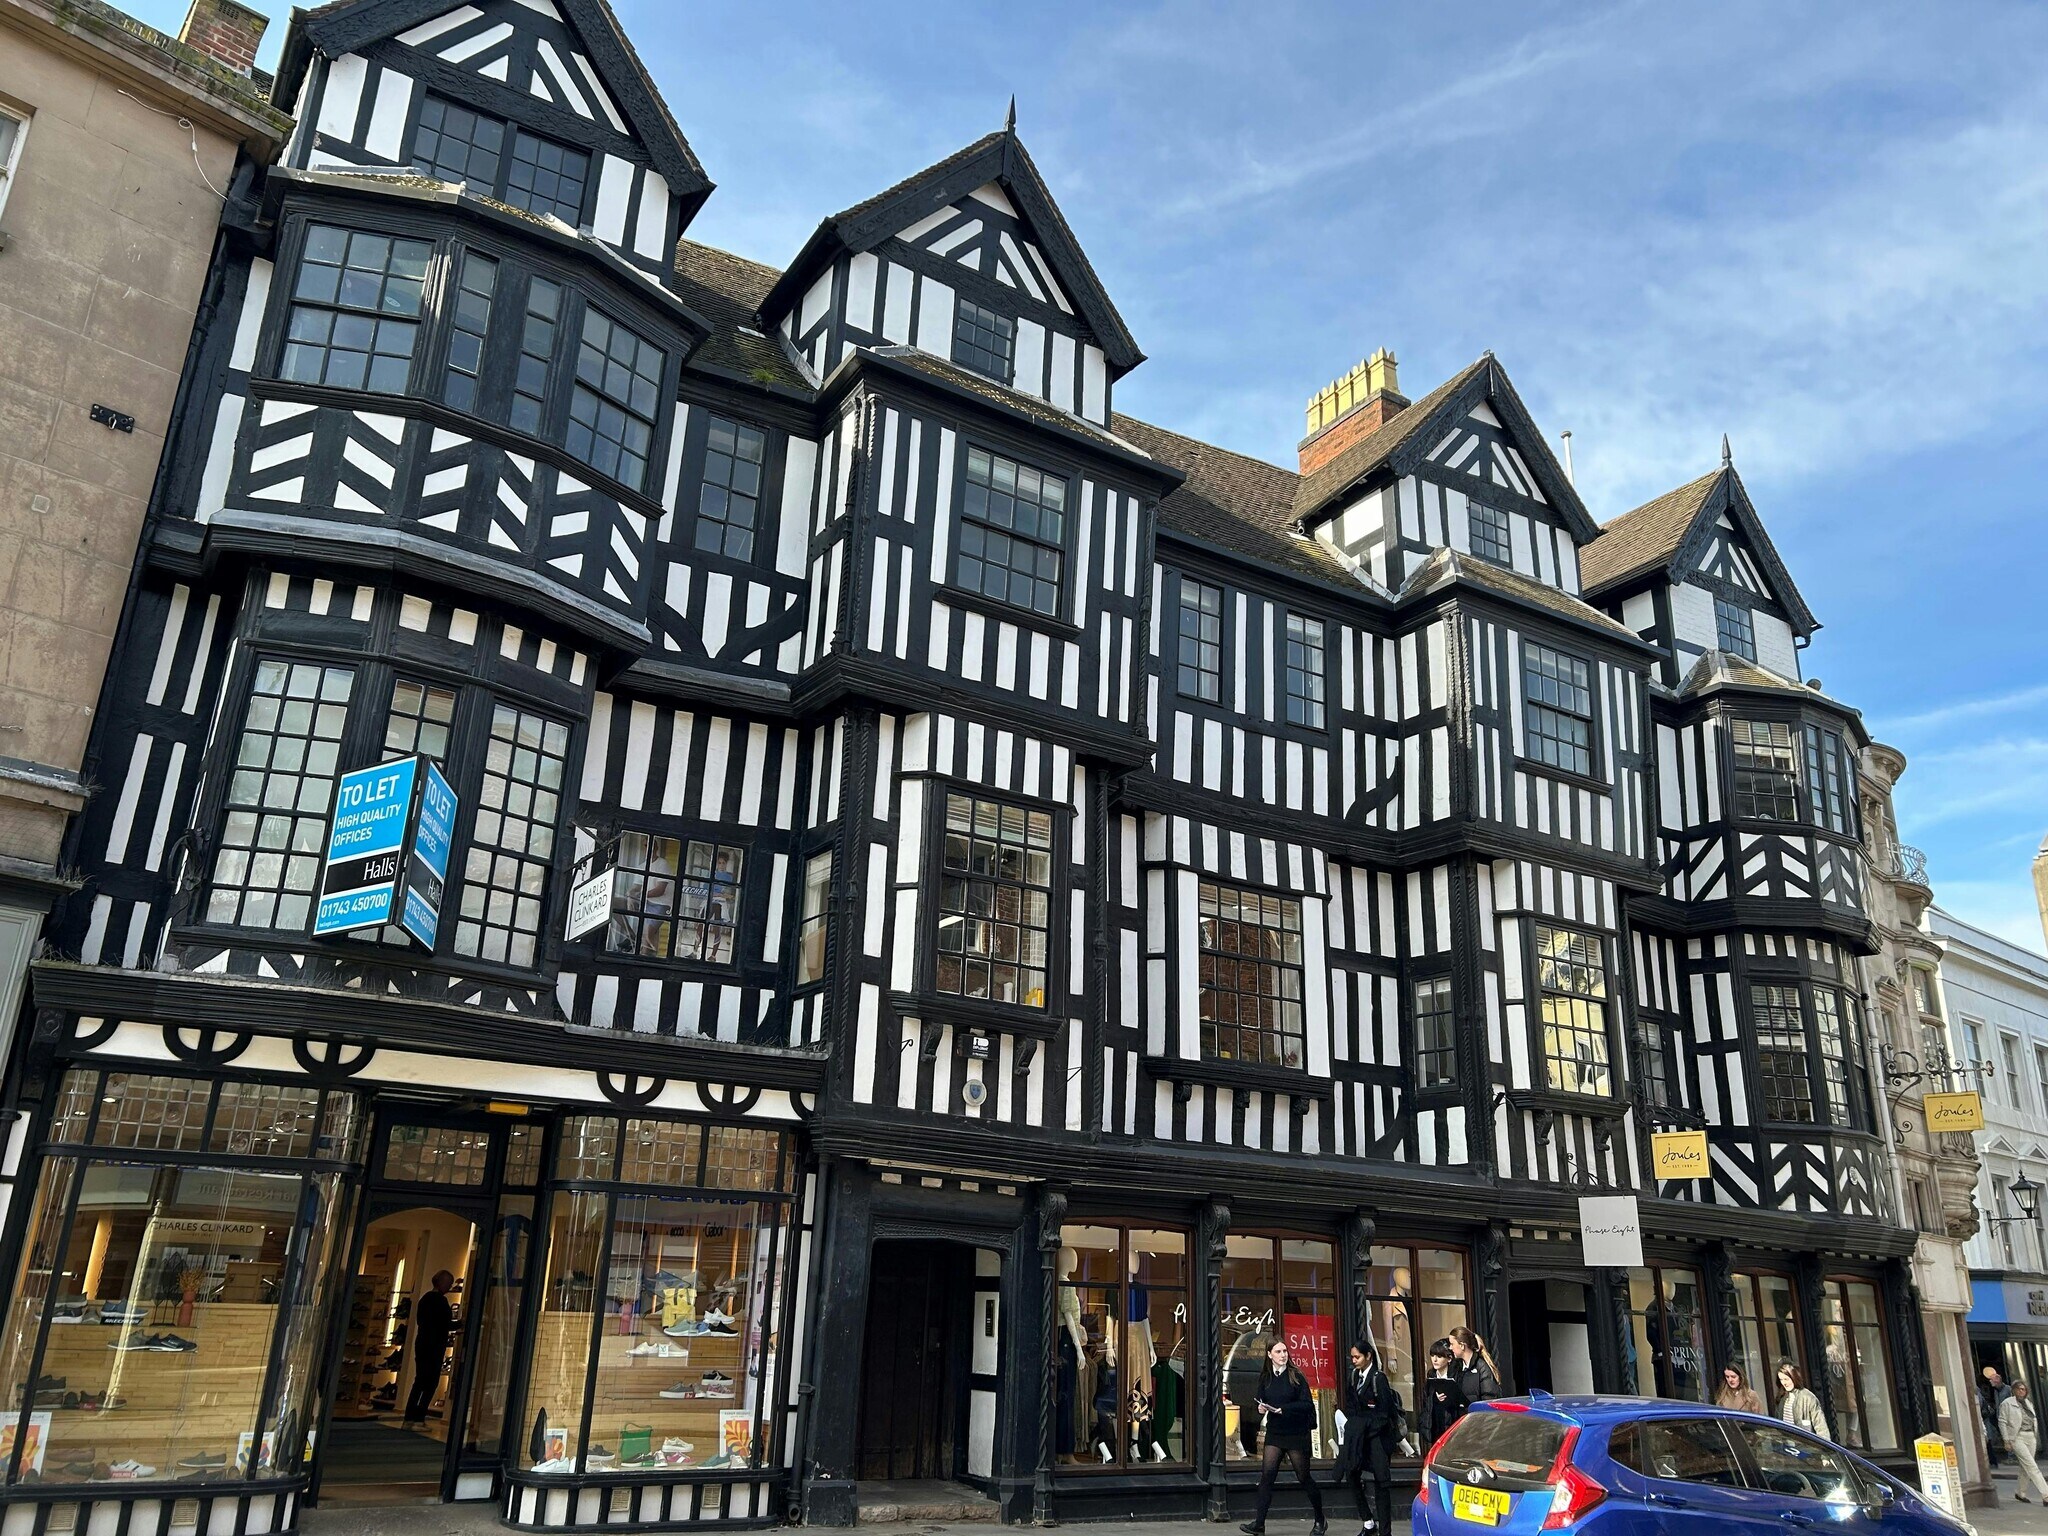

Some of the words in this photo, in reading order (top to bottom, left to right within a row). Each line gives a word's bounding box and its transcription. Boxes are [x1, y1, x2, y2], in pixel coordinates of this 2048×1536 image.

[342, 783, 363, 809] TO
[365, 774, 400, 803] LET
[426, 777, 436, 806] TO
[436, 789, 451, 823] LET
[336, 812, 360, 830] HIGH
[360, 802, 402, 824] QUALITY
[334, 826, 373, 847] OFFICES
[363, 856, 395, 881] Halls
[578, 879, 607, 906] CHARLES
[321, 900, 351, 919] 01743
[351, 892, 388, 912] 450700
[574, 893, 608, 923] CLINKARD
[153, 1221, 198, 1232] CHARLES
[200, 1223, 254, 1234] CLINKARD
[1585, 1225, 1611, 1234] Phase
[1611, 1224, 1635, 1236] Eight
[1290, 1334, 1328, 1351] SALE
[1670, 1346, 1704, 1360] SPRING
[1311, 1358, 1329, 1368] OFF
[1458, 1488, 1480, 1505] OE16
